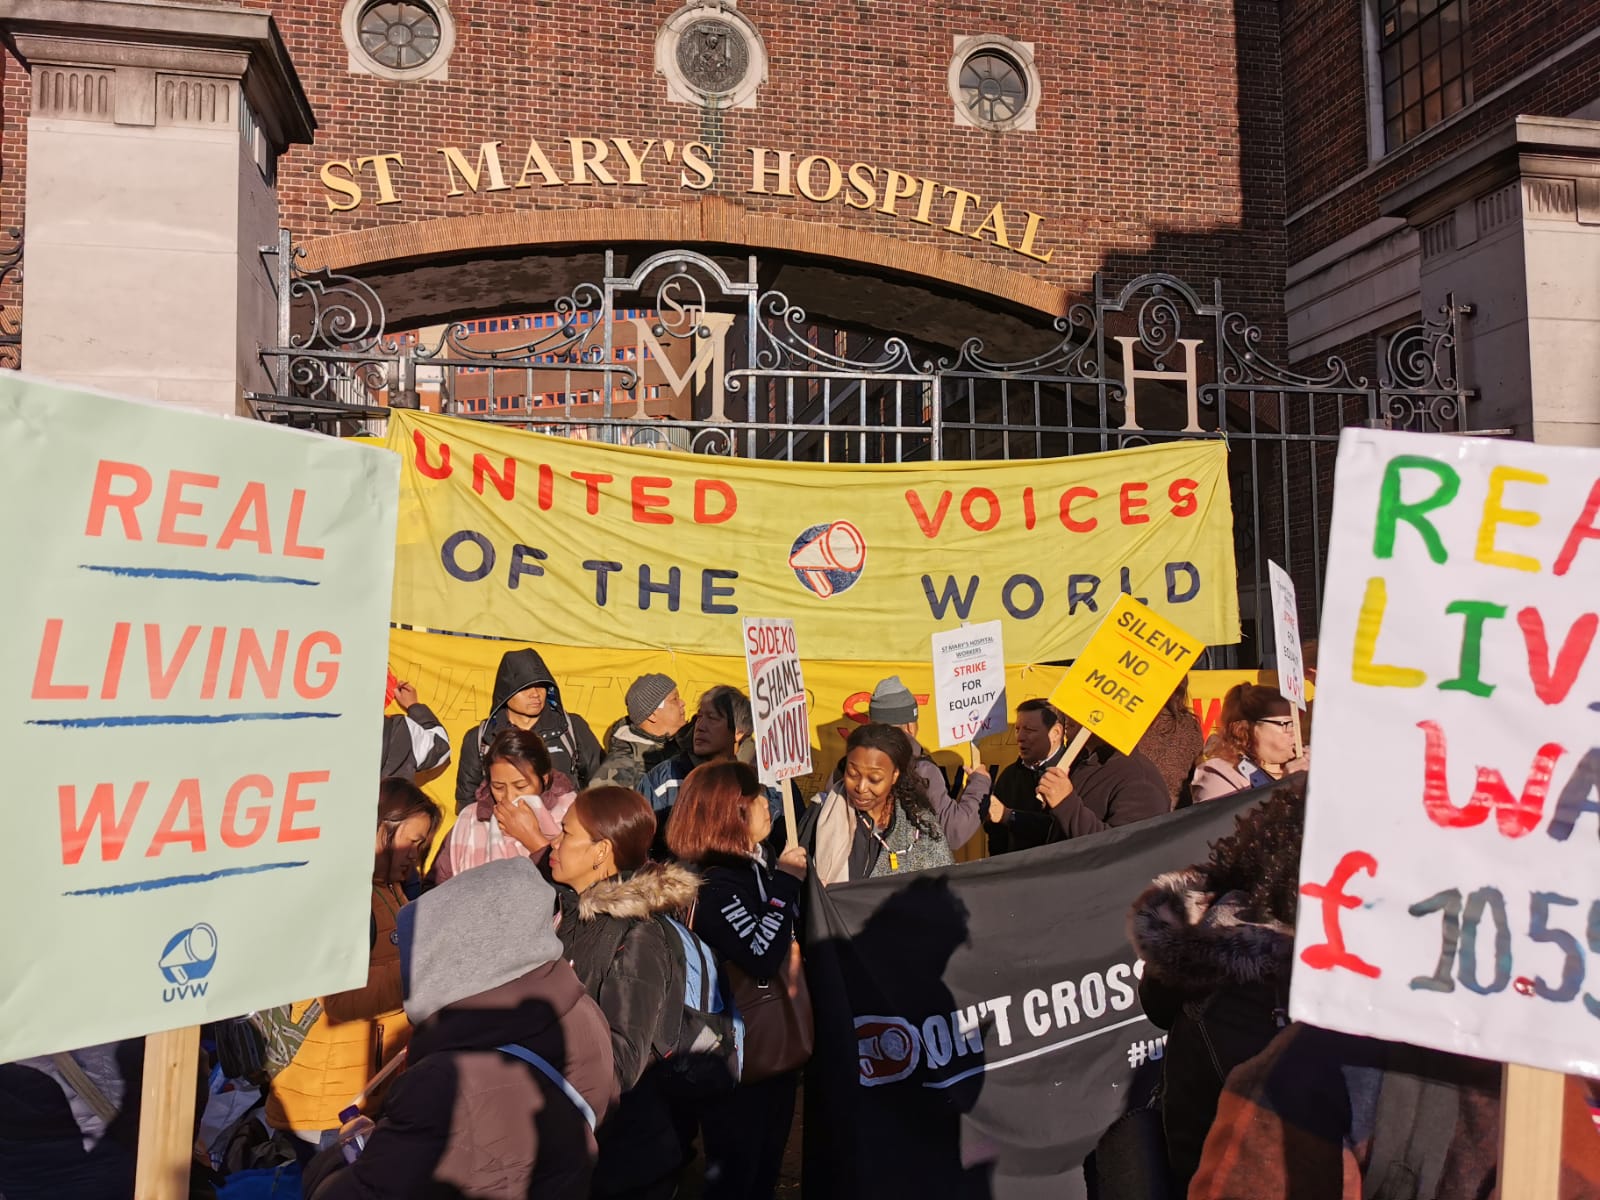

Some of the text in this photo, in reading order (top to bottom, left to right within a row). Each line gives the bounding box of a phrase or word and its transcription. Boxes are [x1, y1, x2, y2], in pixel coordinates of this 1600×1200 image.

[319, 136, 1055, 264] ST MARY'S HOSPITAL
[413, 429, 1199, 538] UNITED VOICES
[85, 459, 325, 560] REAL
[441, 530, 548, 590] OF
[582, 559, 739, 615] THE
[31, 618, 342, 700] LIVING
[747, 625, 796, 656] SODEXO
[1117, 611, 1191, 662] SILENT
[953, 661, 987, 677] STRIKE
[962, 679, 982, 692] FOR
[1118, 650, 1150, 676] NO
[756, 659, 804, 721] SHAME
[949, 691, 996, 712] EQUALITY
[1085, 669, 1144, 713] MORE
[761, 722, 781, 771] ON
[777, 702, 811, 769] YOU!
[952, 717, 992, 740] UVW
[58, 770, 331, 866] WAGE
[162, 981, 209, 1003] UVW
[1127, 1034, 1168, 1069] #U
